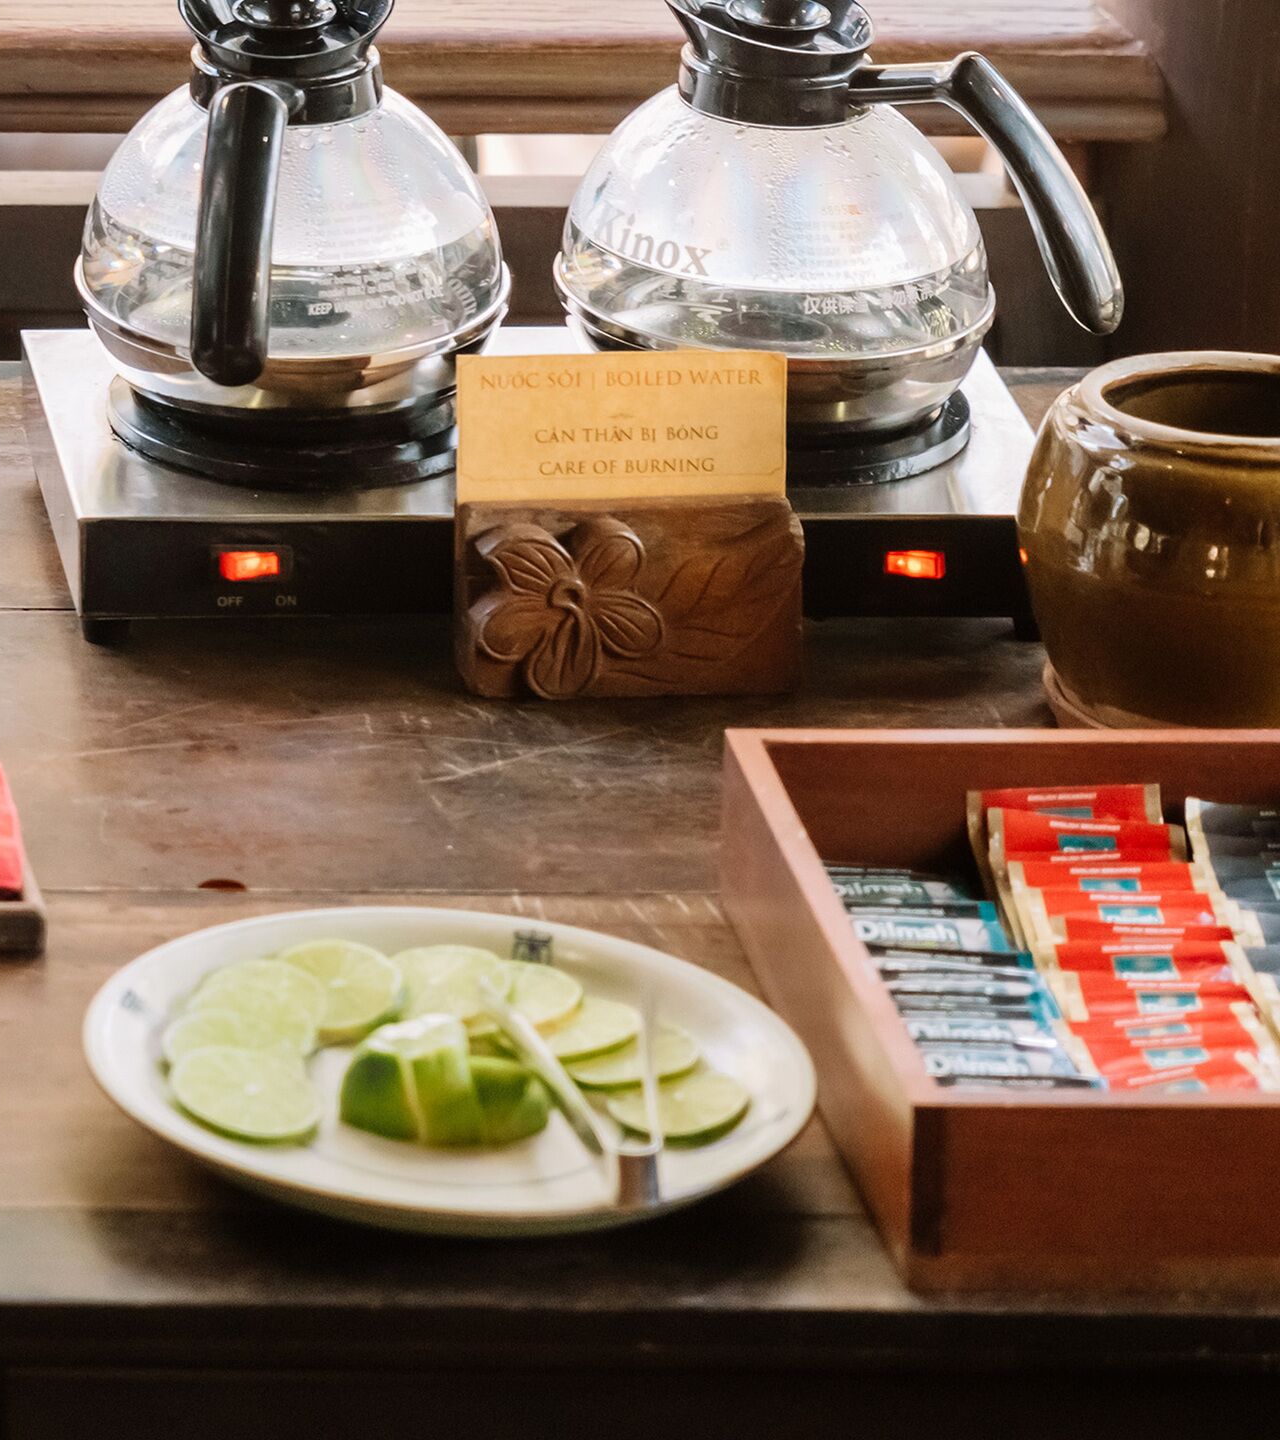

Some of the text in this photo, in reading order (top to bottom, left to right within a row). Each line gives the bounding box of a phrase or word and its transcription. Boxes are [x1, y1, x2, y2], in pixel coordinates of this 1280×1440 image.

[594, 200, 712, 276] Kinox
[606, 369, 682, 388] BOILED
[689, 368, 762, 386] WATER
[539, 458, 716, 476] CARE OF BURNING
[216, 595, 297, 607] OFF ON
[855, 920, 957, 941] Dilmah
